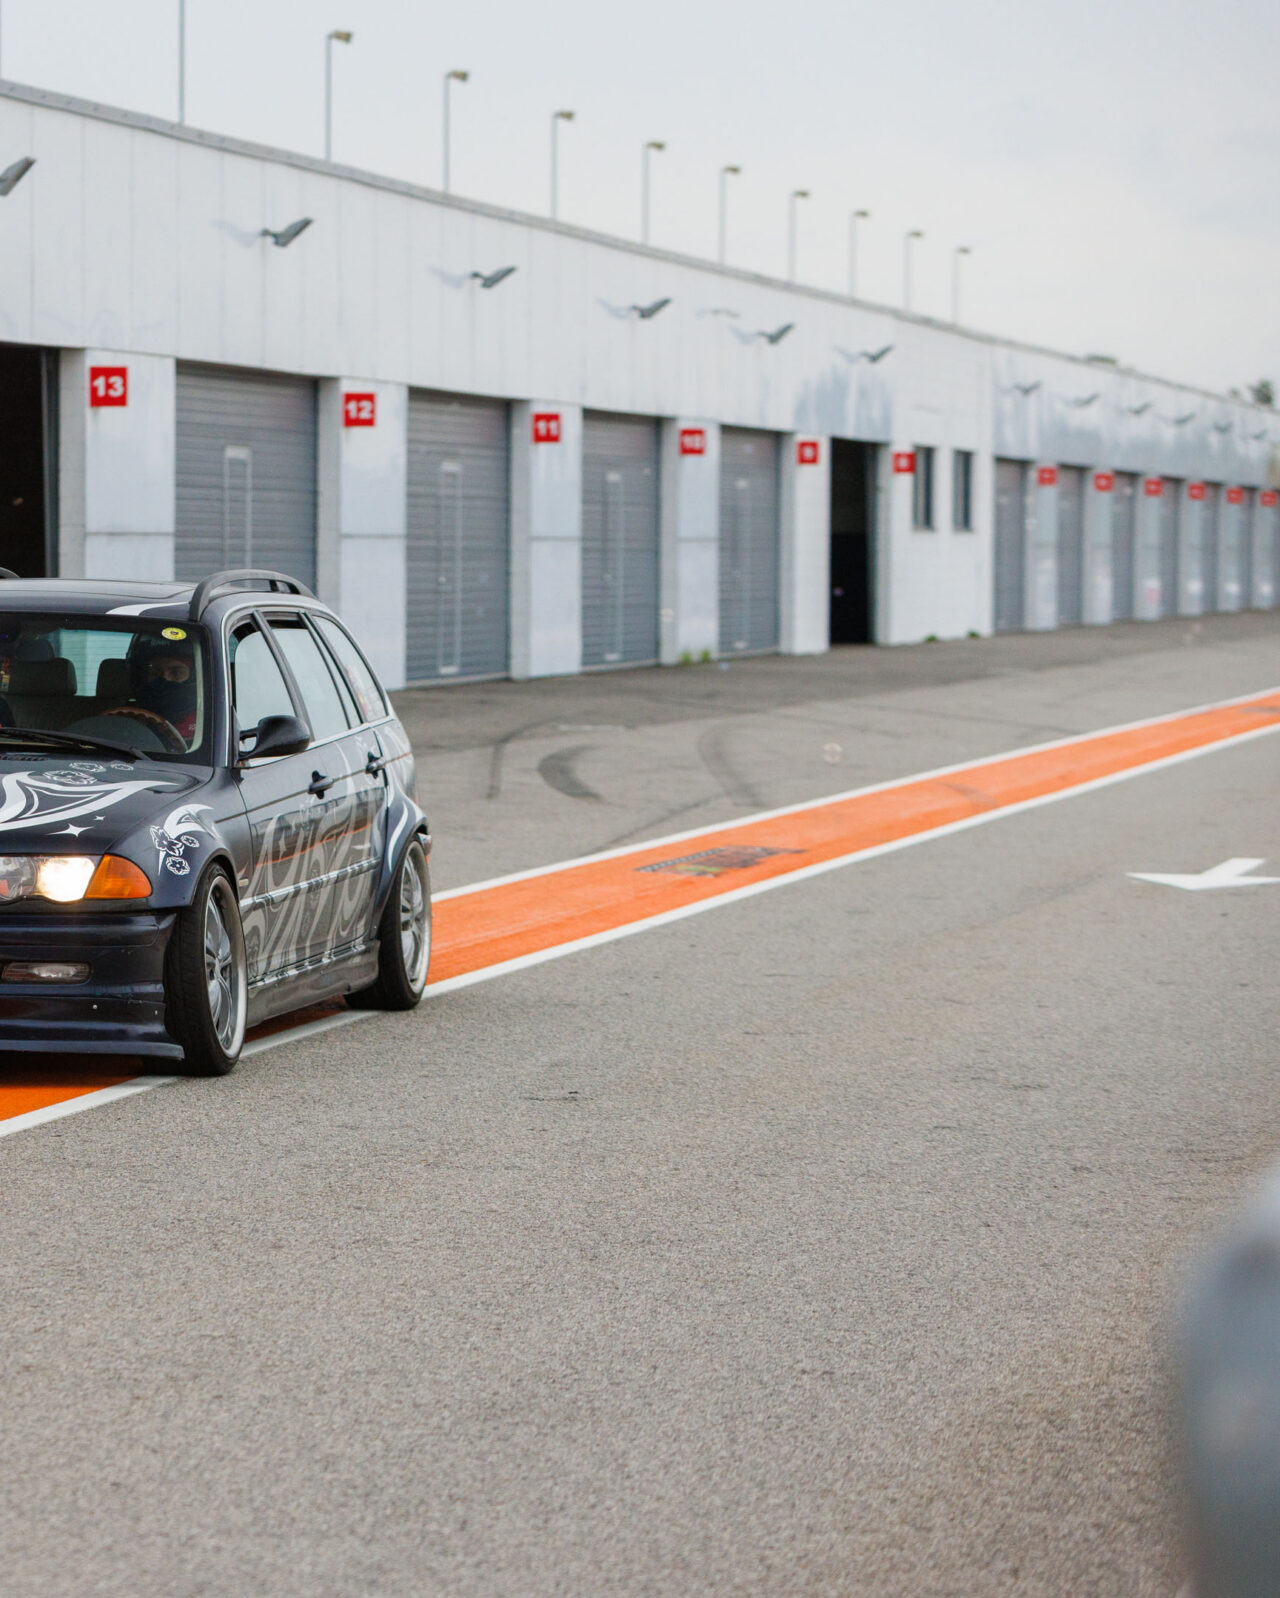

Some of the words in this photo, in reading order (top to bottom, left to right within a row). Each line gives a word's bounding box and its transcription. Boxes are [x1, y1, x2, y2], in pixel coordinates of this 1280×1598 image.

[92, 375, 125, 397] 13
[345, 401, 373, 419] 12
[535, 420, 559, 436] 11
